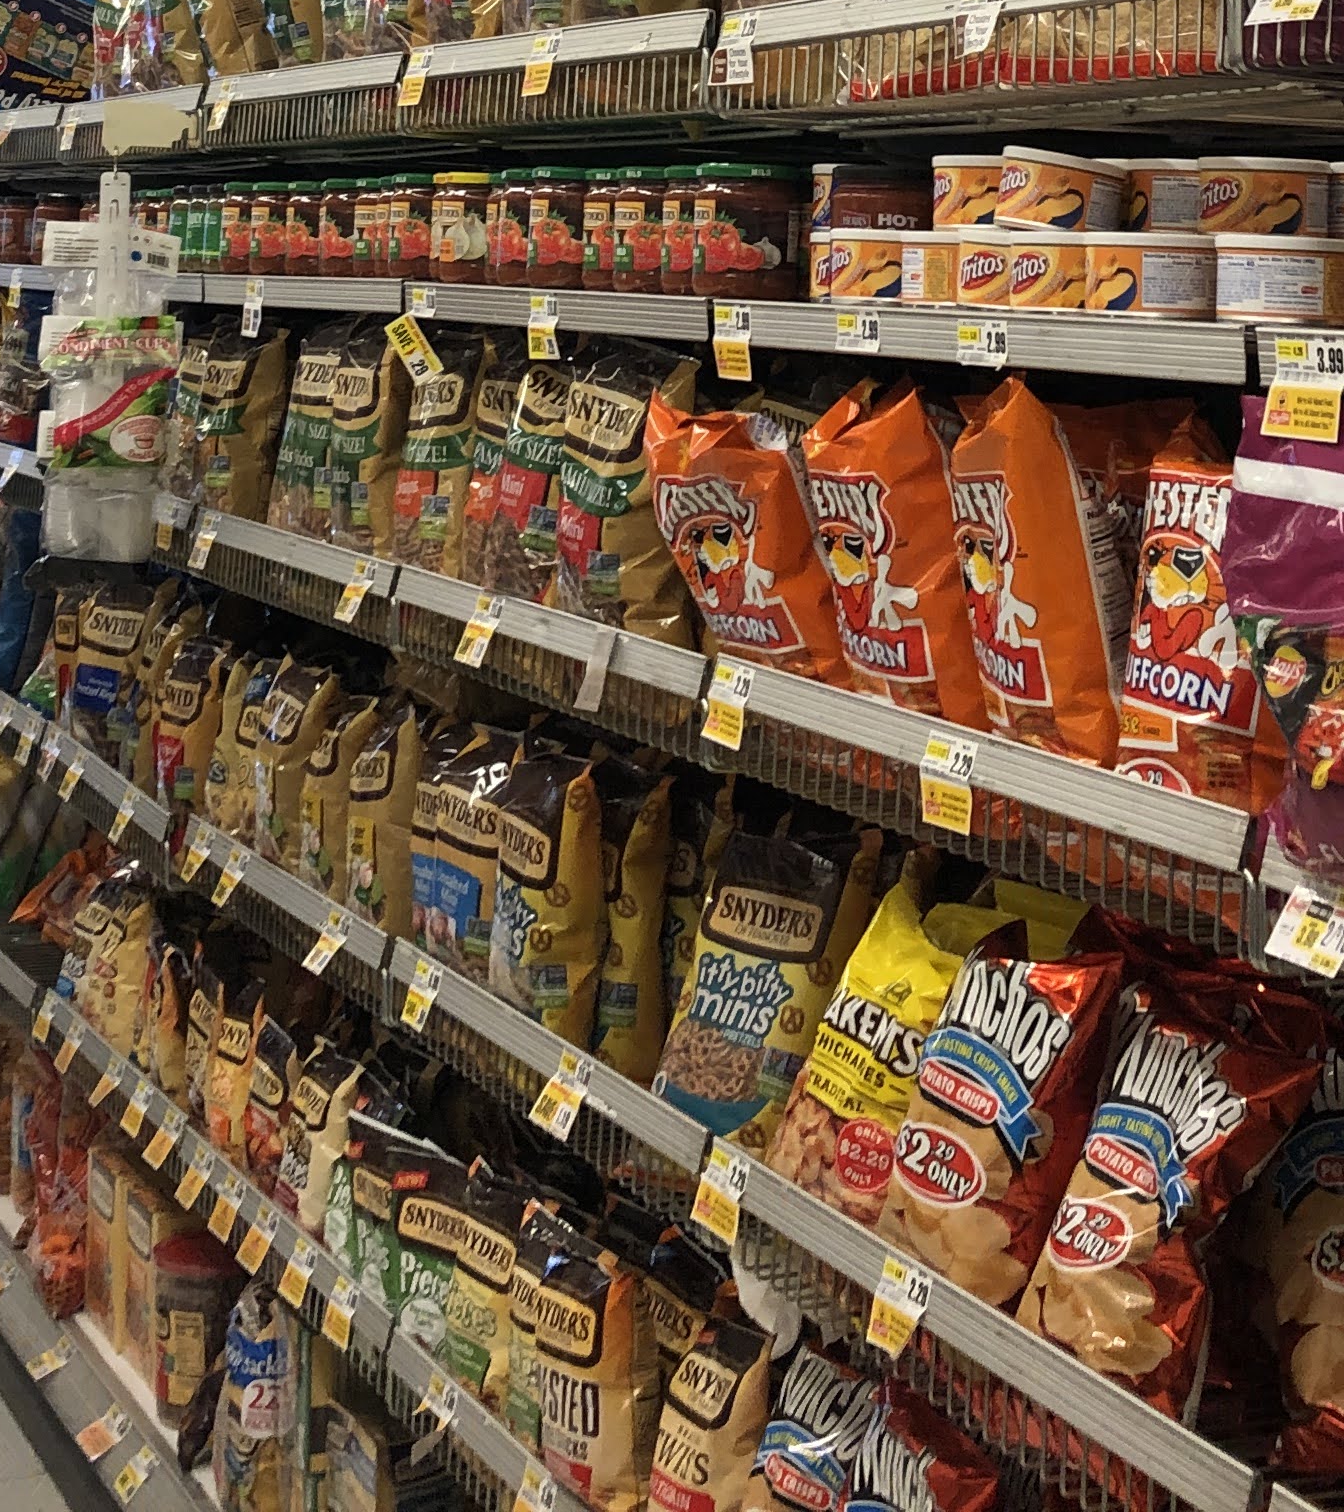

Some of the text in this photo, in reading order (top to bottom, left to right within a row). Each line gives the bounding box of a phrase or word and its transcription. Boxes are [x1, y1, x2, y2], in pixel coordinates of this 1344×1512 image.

[877, 213, 919, 230] HOT
[961, 254, 1007, 284] Fritos
[391, 323, 414, 351] SAVE
[987, 330, 1006, 355] 2.99
[1316, 347, 1344, 373] 3.99
[950, 752, 973, 776] 2.29
[719, 892, 815, 940] SNYDER'S
[699, 955, 790, 1005] itty bitty
[692, 988, 776, 1035] minis
[923, 1065, 992, 1116] POTATO CRISPS
[839, 1138, 890, 1172] $2.29
[1091, 1139, 1132, 1177] POTATO
[928, 1165, 972, 1199] ONLY
[536, 1290, 591, 1342] NYDER'S
